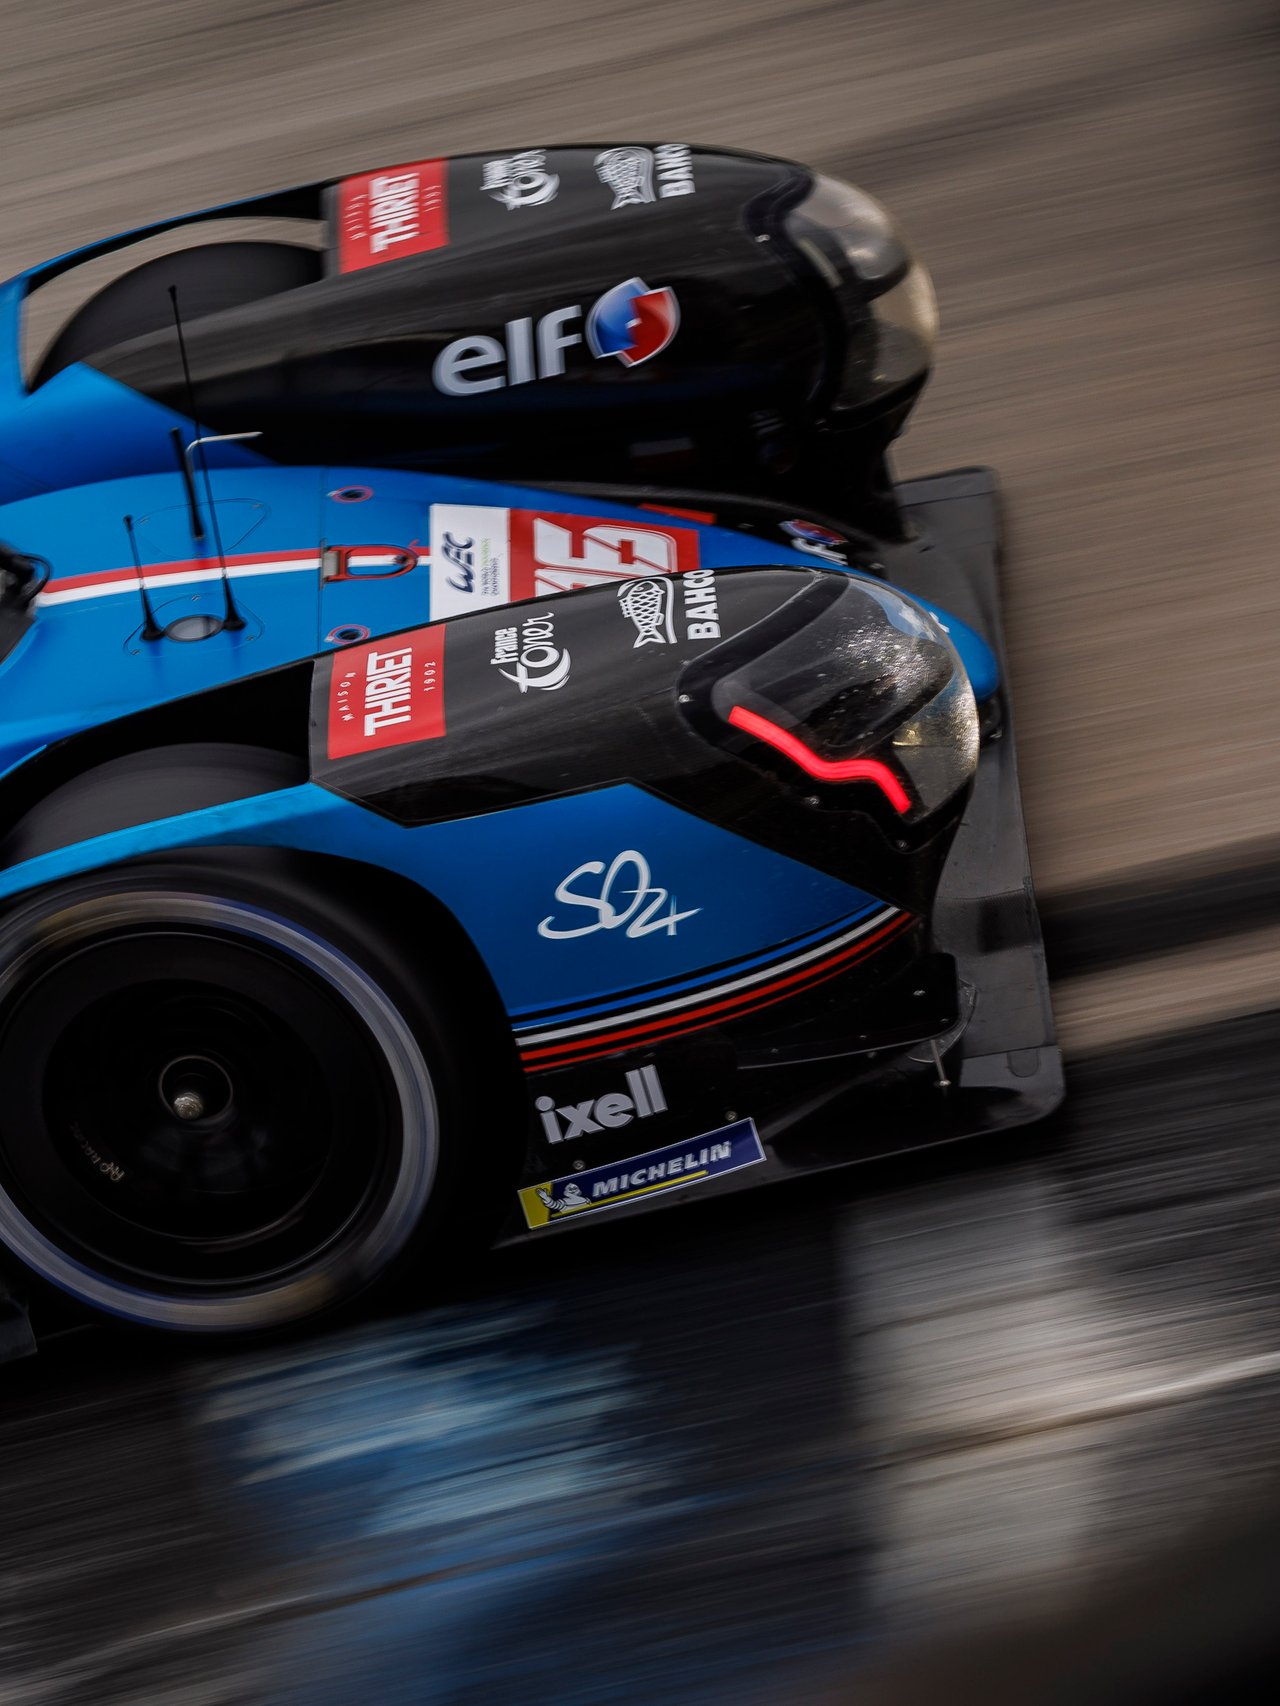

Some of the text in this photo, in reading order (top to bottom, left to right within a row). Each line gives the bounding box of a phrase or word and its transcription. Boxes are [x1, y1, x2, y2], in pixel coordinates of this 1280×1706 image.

[368, 172, 420, 254] THIRIET
[432, 304, 582, 397] elf
[442, 531, 475, 593] WEC
[683, 569, 722, 640] BAHCO
[423, 660, 437, 692] 1902
[490, 626, 519, 665] France
[336, 671, 357, 722] MAISON
[363, 646, 414, 737] THIRIET
[535, 1063, 669, 1145] ixell
[592, 1140, 733, 1199] MICHELIN
